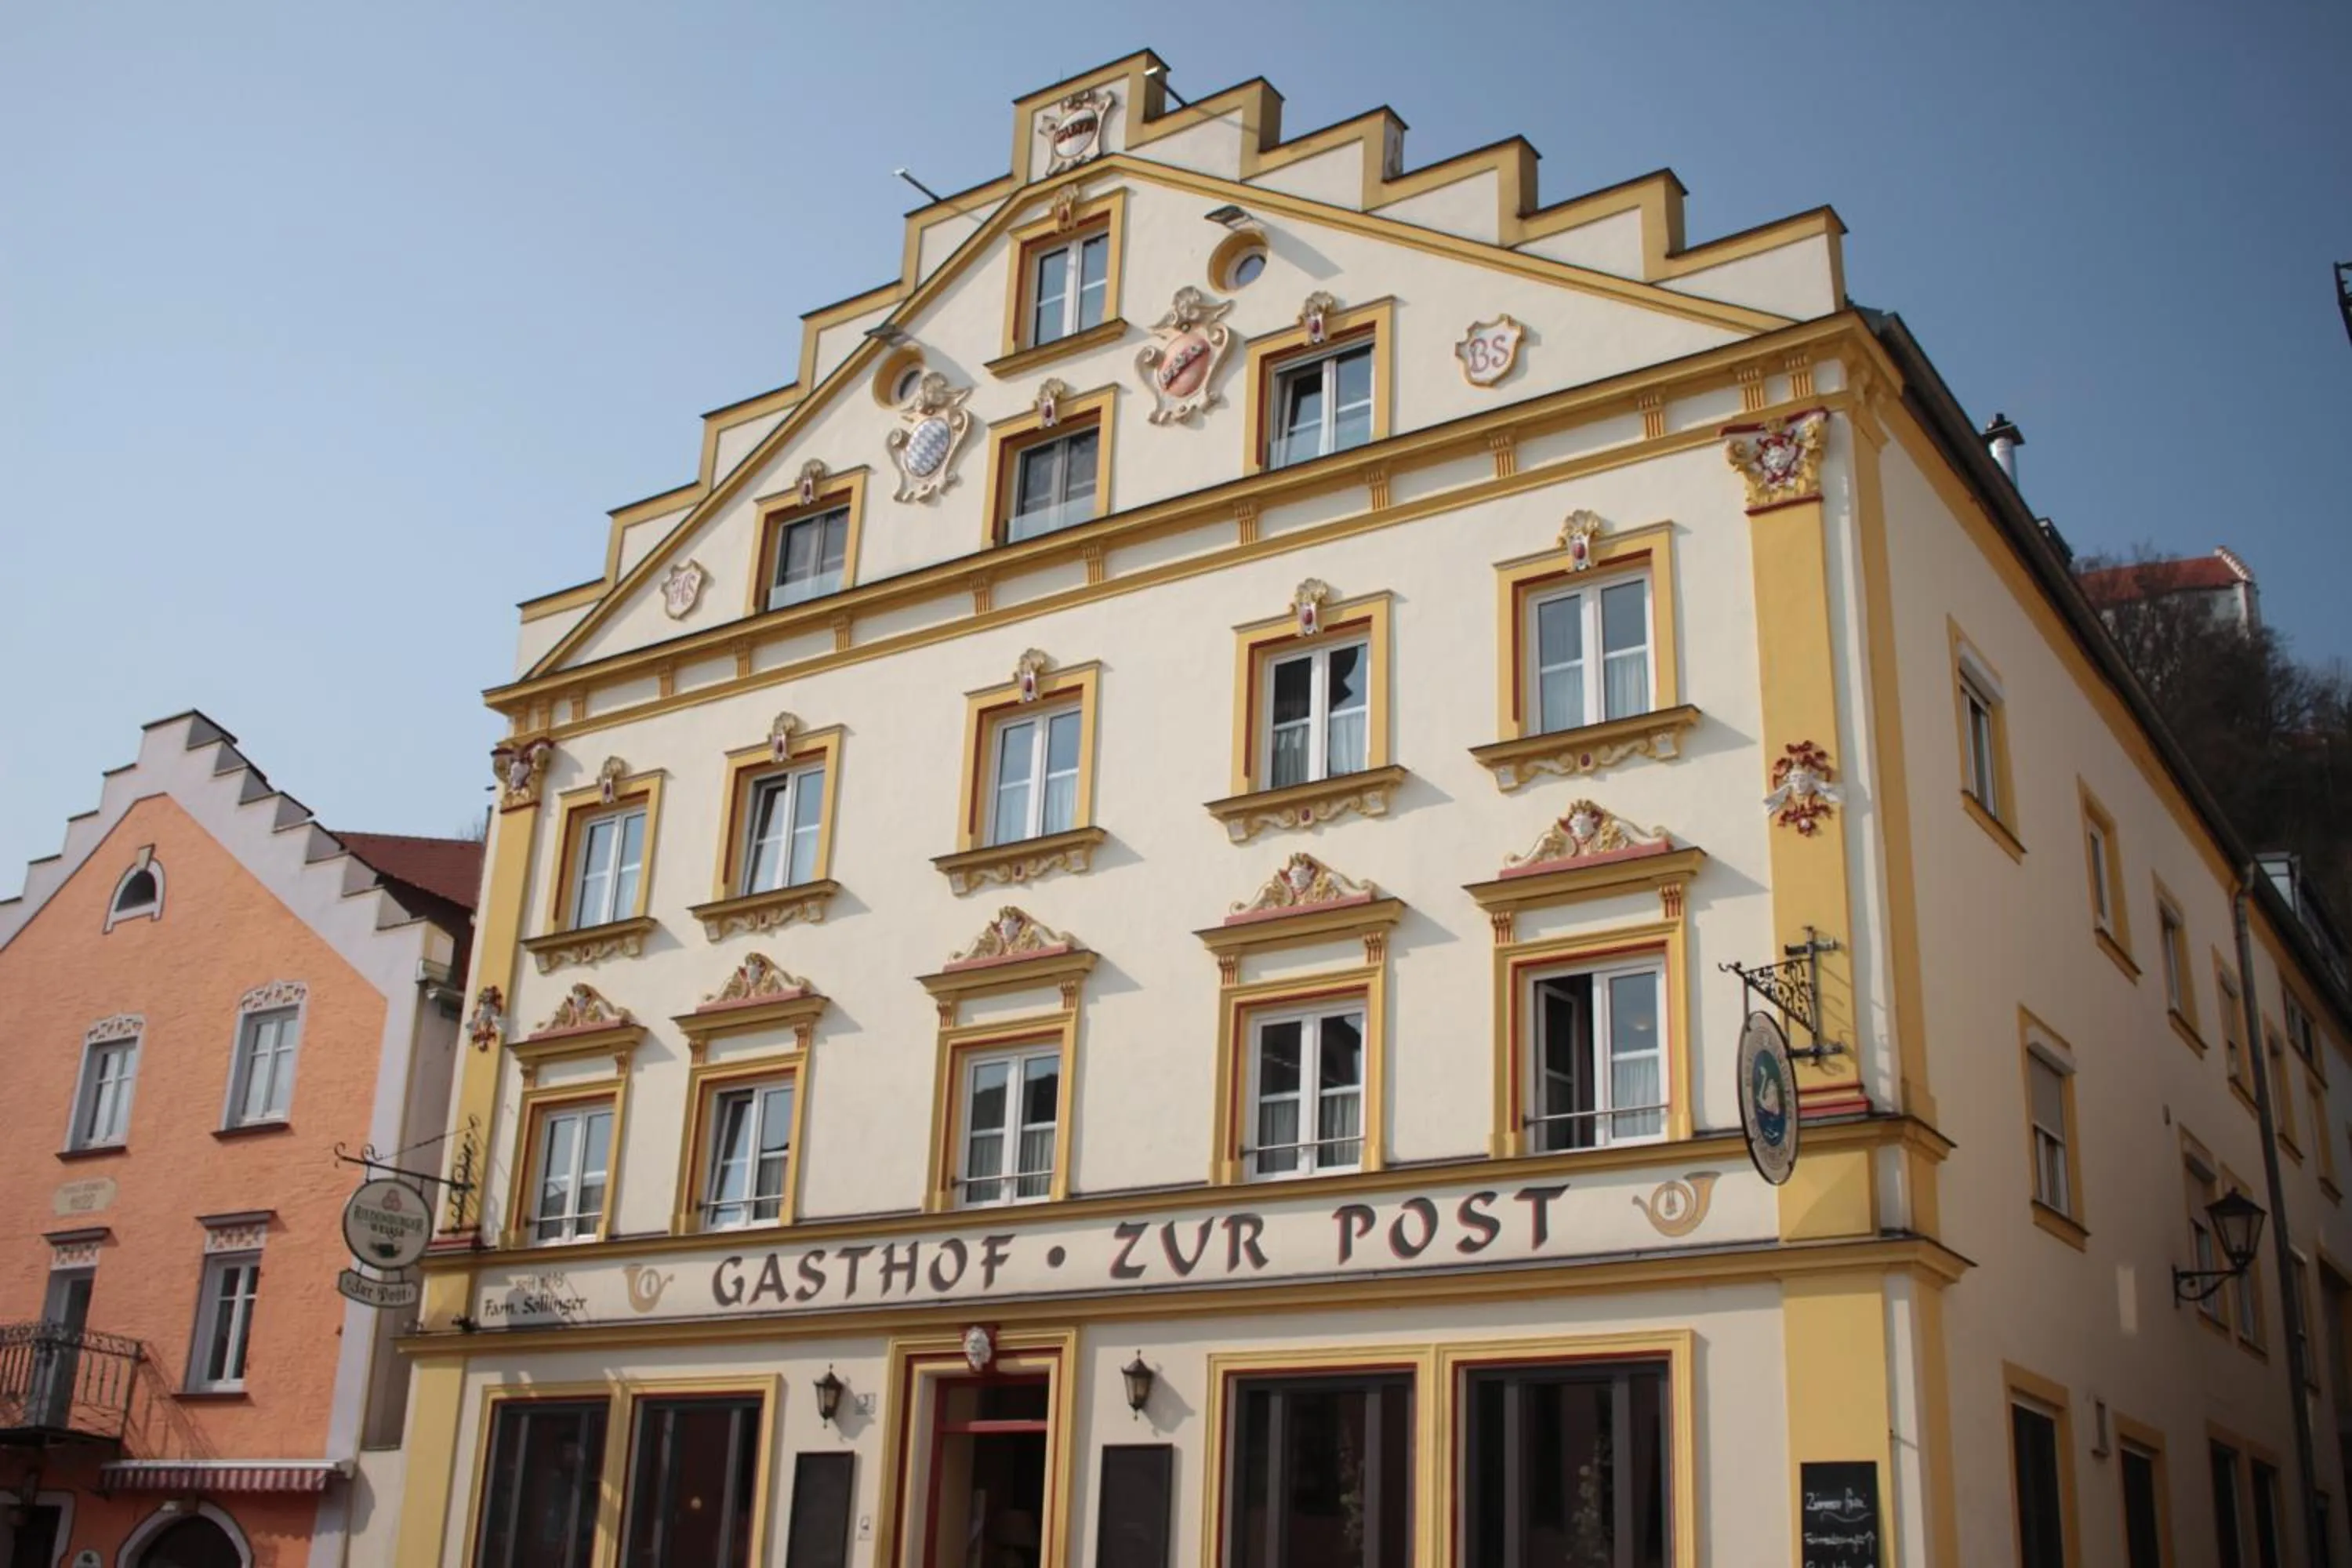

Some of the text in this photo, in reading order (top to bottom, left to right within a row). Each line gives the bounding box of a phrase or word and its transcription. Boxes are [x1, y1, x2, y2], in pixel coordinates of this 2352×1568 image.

[711, 1183, 1571, 1308] GASTHOF ZUR POST
